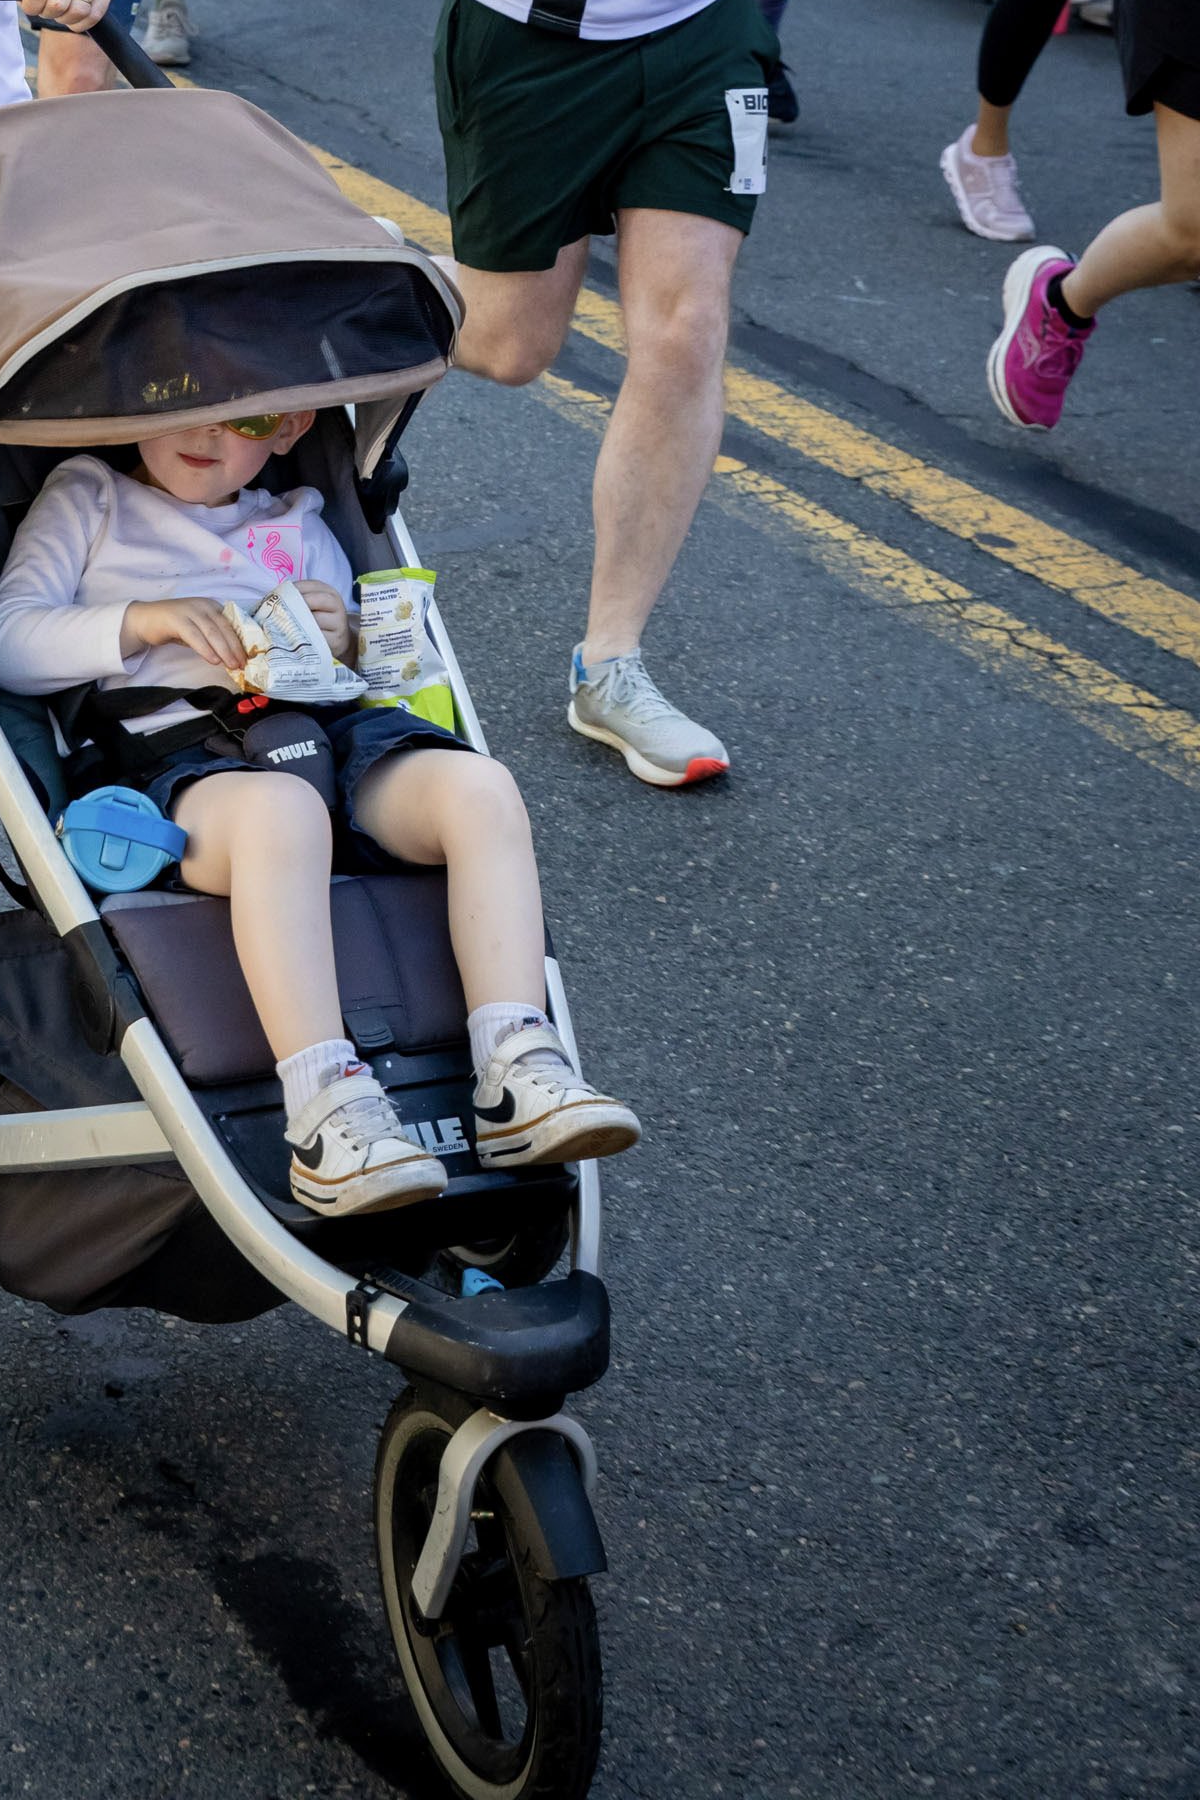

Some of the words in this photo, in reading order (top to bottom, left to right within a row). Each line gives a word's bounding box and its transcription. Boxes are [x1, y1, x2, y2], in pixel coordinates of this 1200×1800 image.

[380, 587, 399, 595] POPPED
[266, 739, 318, 765] THULE
[432, 1142, 464, 1153] SWEDEN
